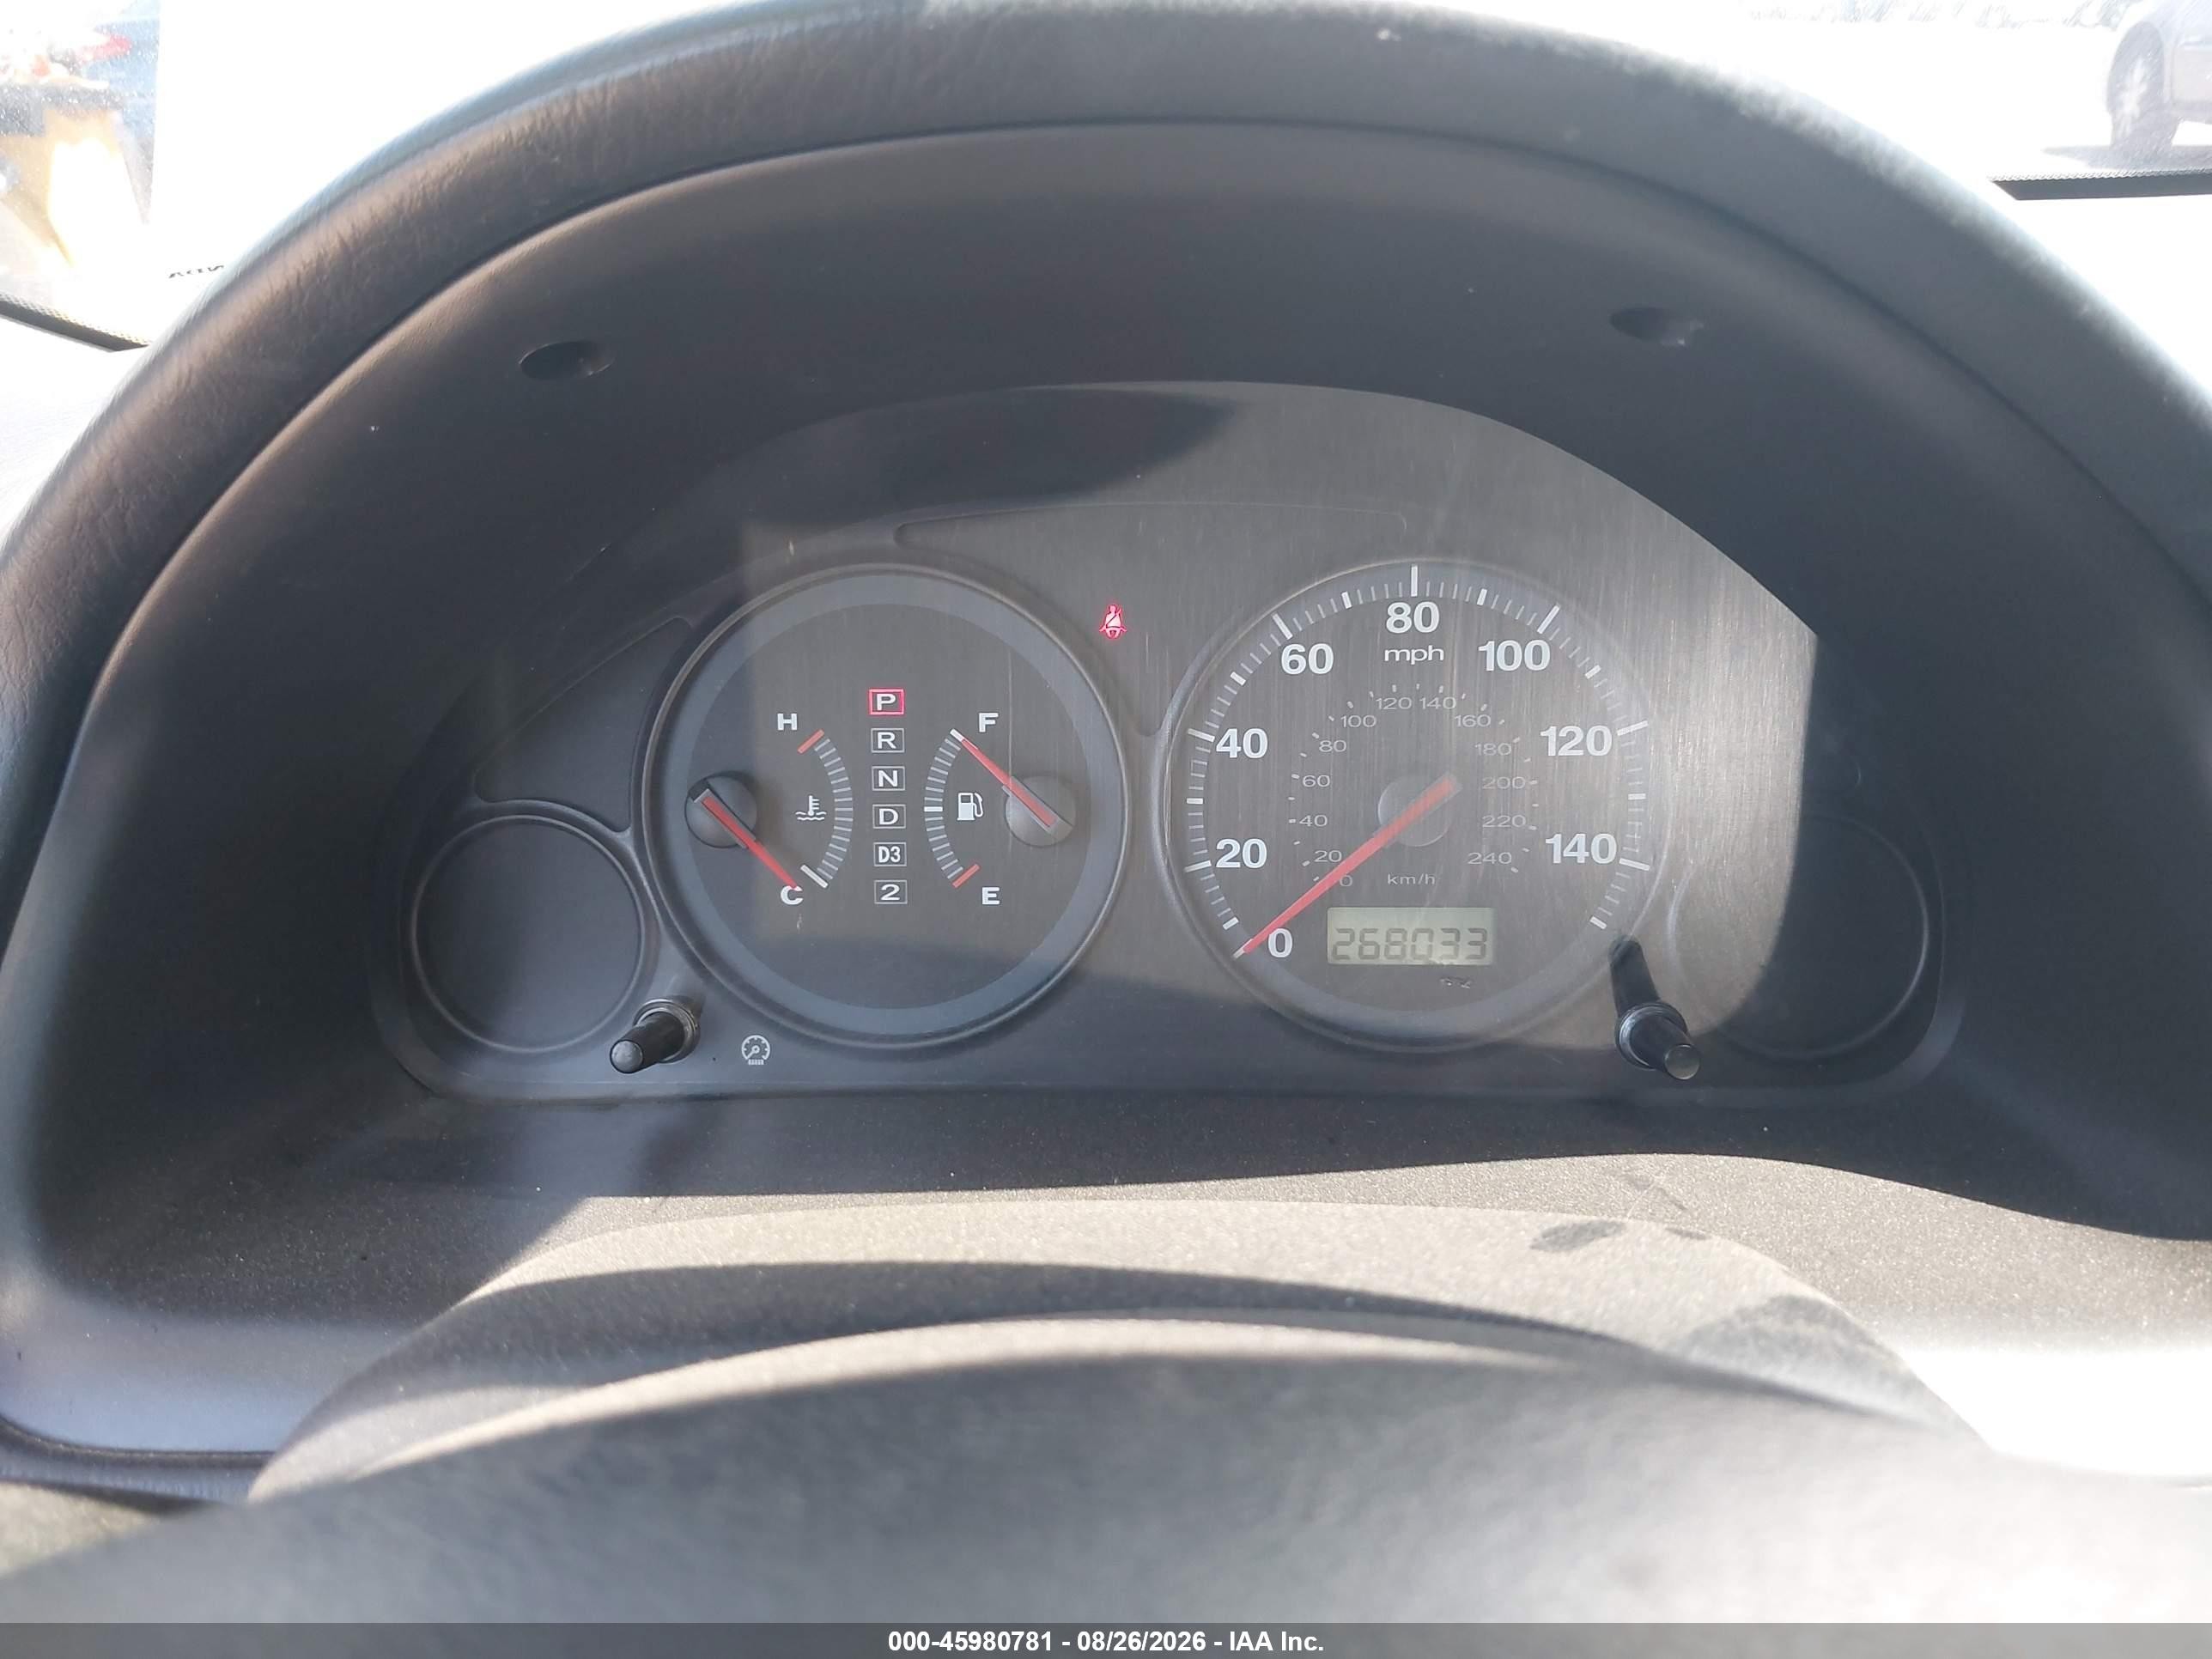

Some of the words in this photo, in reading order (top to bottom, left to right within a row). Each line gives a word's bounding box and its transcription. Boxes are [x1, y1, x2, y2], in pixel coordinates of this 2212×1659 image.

[1386, 601, 1440, 634] 80
[1279, 643, 1334, 675] 60
[1384, 645, 1444, 665] mph
[1478, 639, 1551, 672] 100
[876, 693, 896, 711] P
[1376, 696, 1413, 710] 120
[1422, 696, 1457, 709] 140
[777, 713, 798, 731] H
[978, 712, 999, 732] F
[1340, 714, 1376, 728] 100
[1454, 714, 1492, 727] 160
[877, 732, 896, 749] R
[1215, 727, 1269, 759] 40
[1318, 738, 1347, 752] 80
[1540, 725, 1613, 757] 120
[1474, 743, 1512, 757] 180
[878, 769, 898, 787] N
[1302, 775, 1330, 787] 60
[1481, 775, 1527, 790] 200
[878, 808, 899, 825] D
[1298, 814, 1328, 827] 40
[1482, 814, 1527, 828] 220
[878, 846, 901, 863] D3
[1216, 838, 1267, 869] 20
[1314, 849, 1343, 863] 20
[1545, 833, 1617, 864] 140
[1468, 852, 1512, 865] 240
[1339, 874, 1353, 887] 0
[1386, 872, 1437, 886] km/h
[780, 885, 805, 906] C
[880, 884, 900, 901] 2
[981, 886, 1000, 905] E
[1267, 927, 1293, 958] 0
[1331, 927, 1488, 961] 268033
